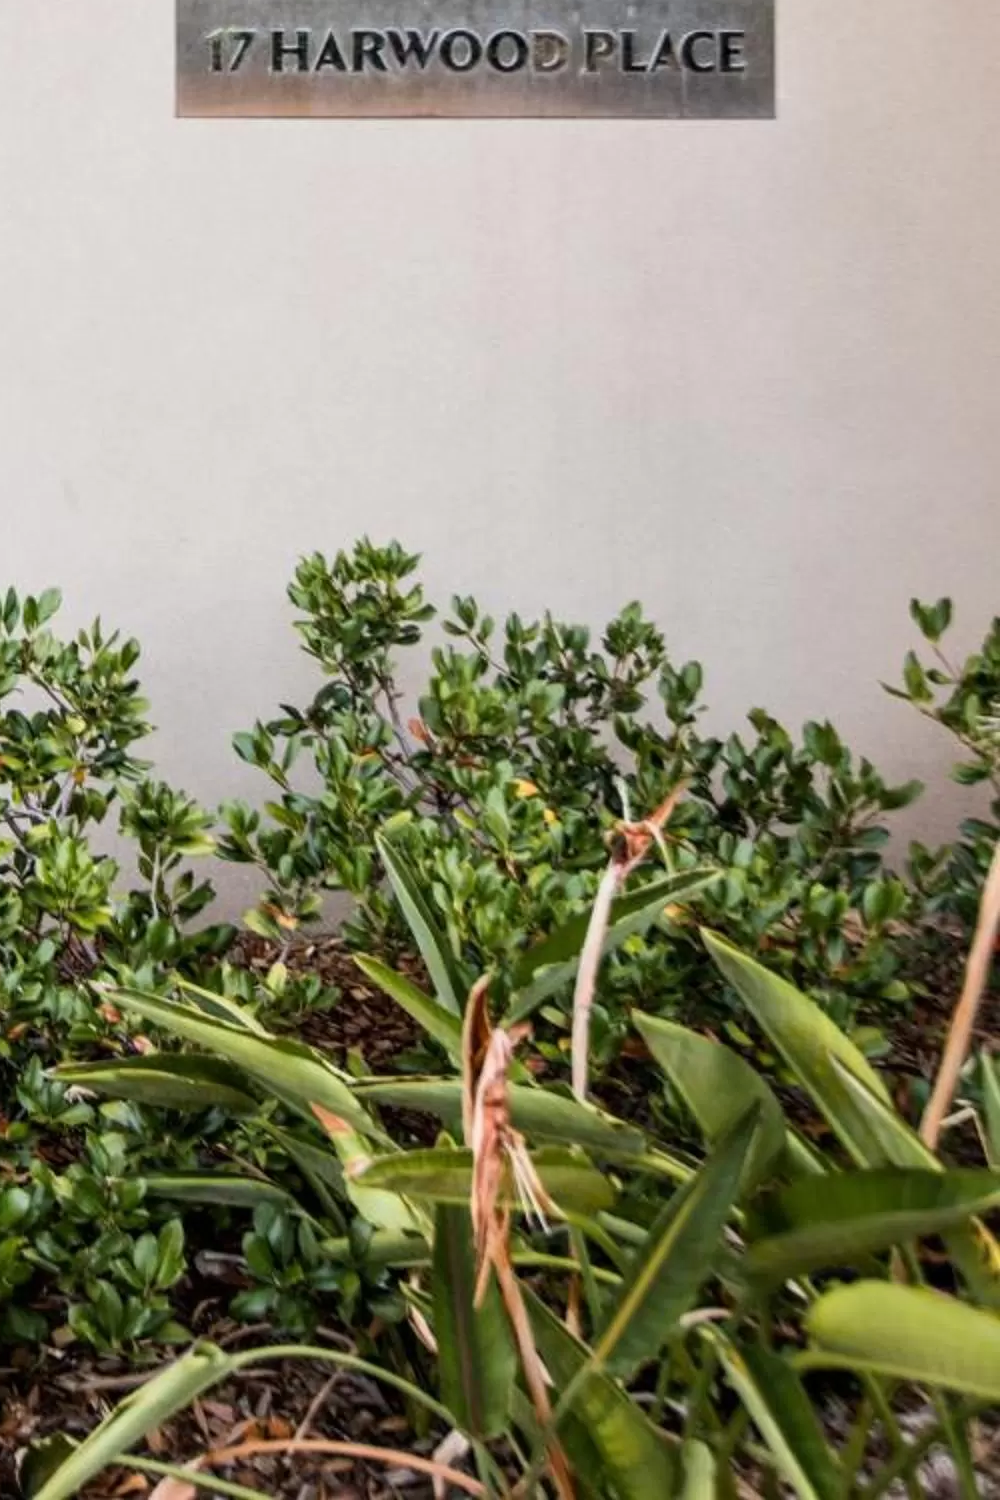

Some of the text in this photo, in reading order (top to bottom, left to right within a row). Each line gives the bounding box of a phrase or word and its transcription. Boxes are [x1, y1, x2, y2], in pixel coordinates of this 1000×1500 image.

[205, 28, 746, 74] 17 HARWOOD PLACE
